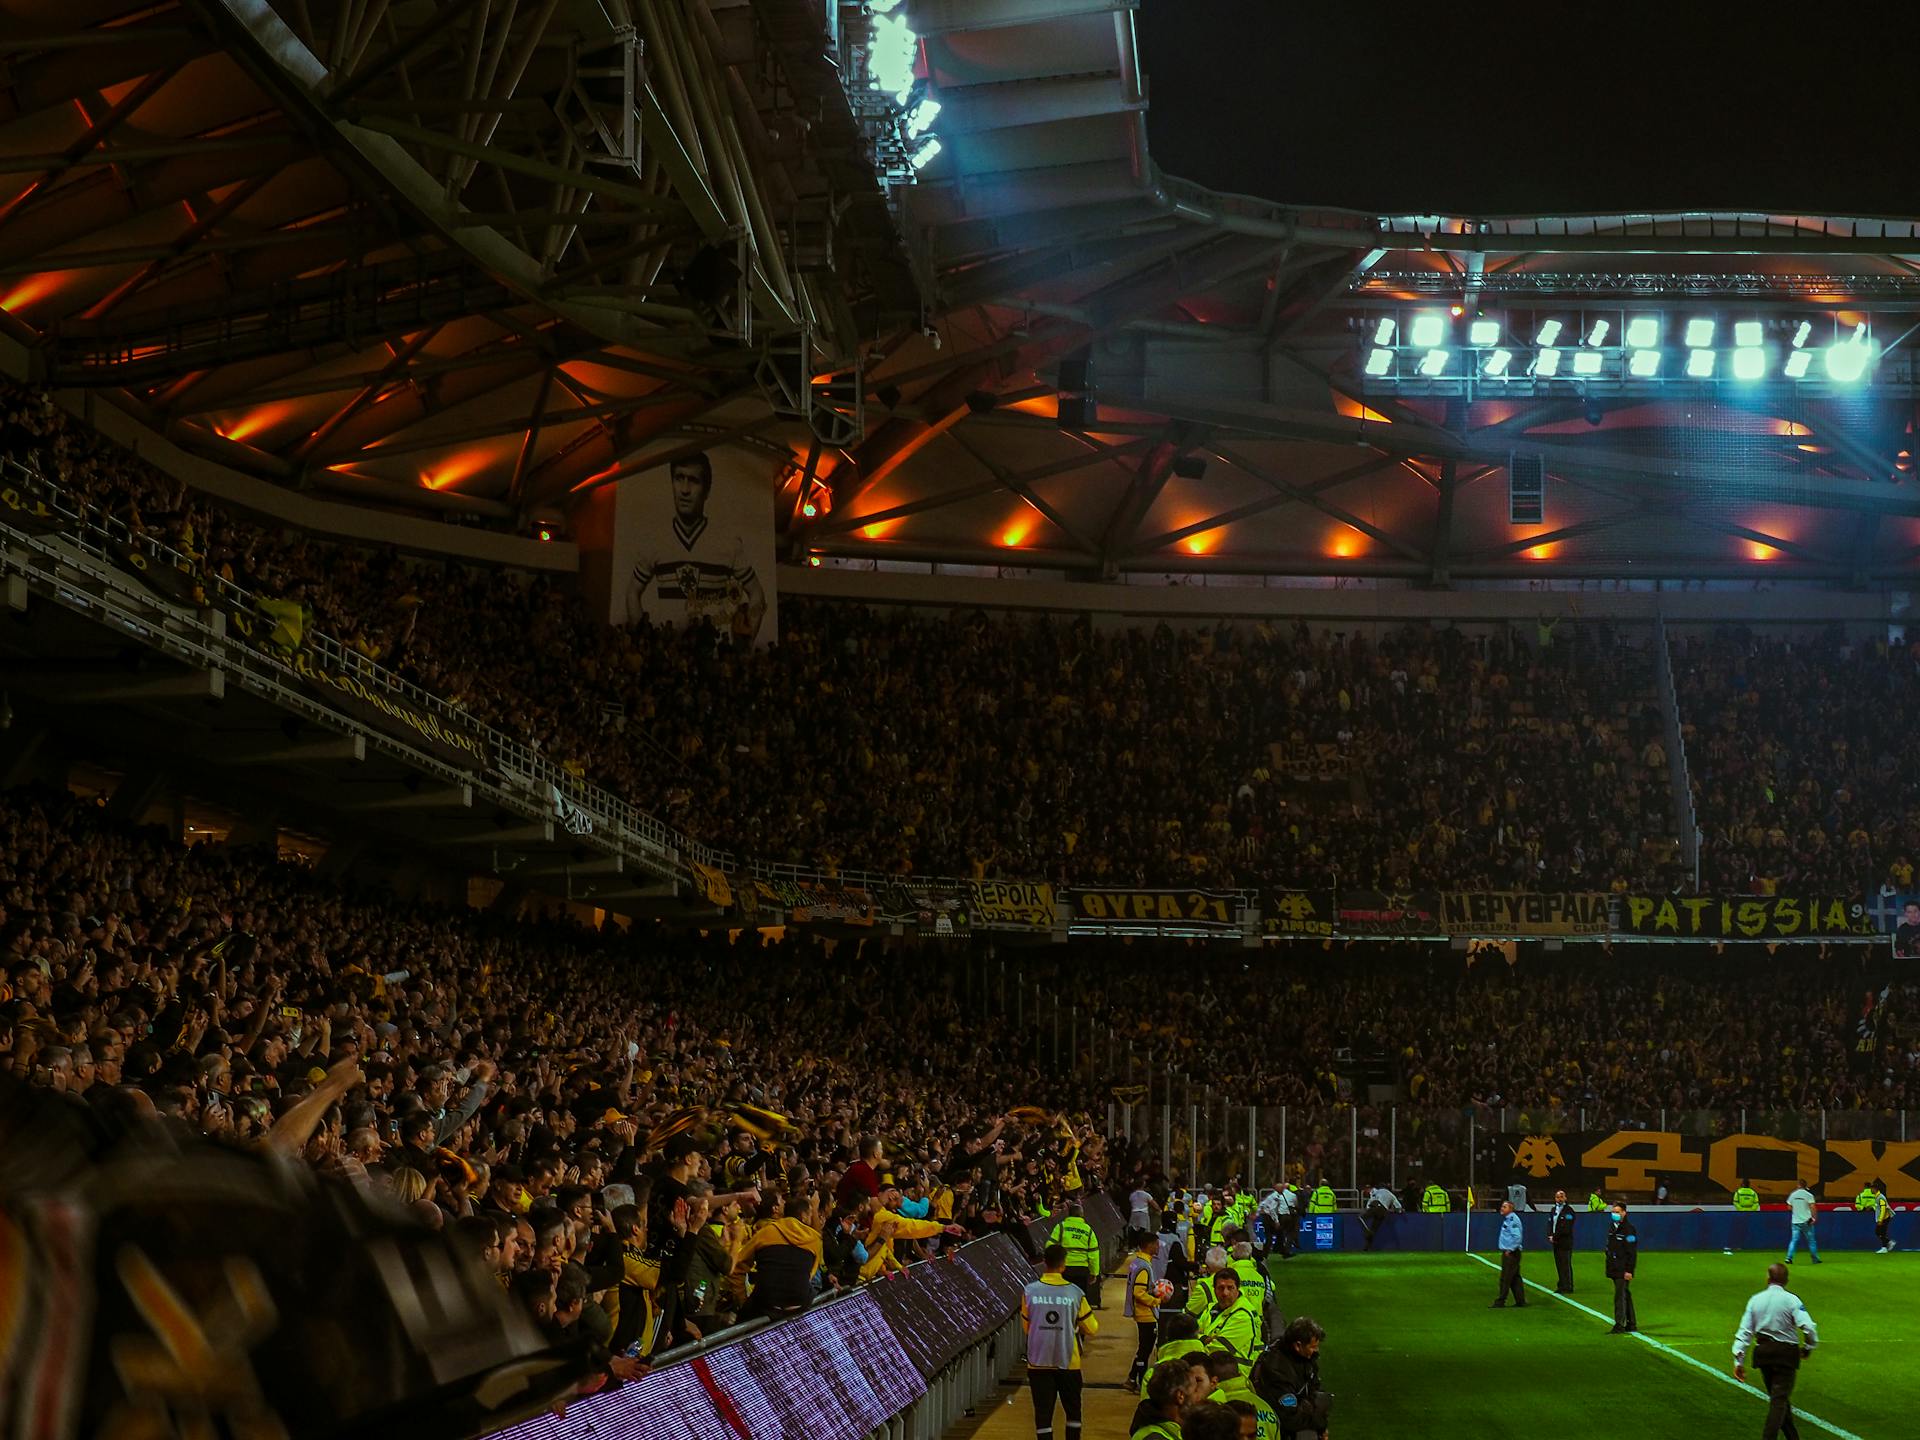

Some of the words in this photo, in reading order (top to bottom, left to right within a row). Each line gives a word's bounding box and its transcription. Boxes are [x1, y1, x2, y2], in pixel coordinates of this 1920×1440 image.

[1081, 893, 1183, 919] ΘΥΡΑ
[1187, 893, 1230, 923] 21
[1626, 895, 1851, 937] PATISSIA
[1032, 1295, 1054, 1305] BALL
